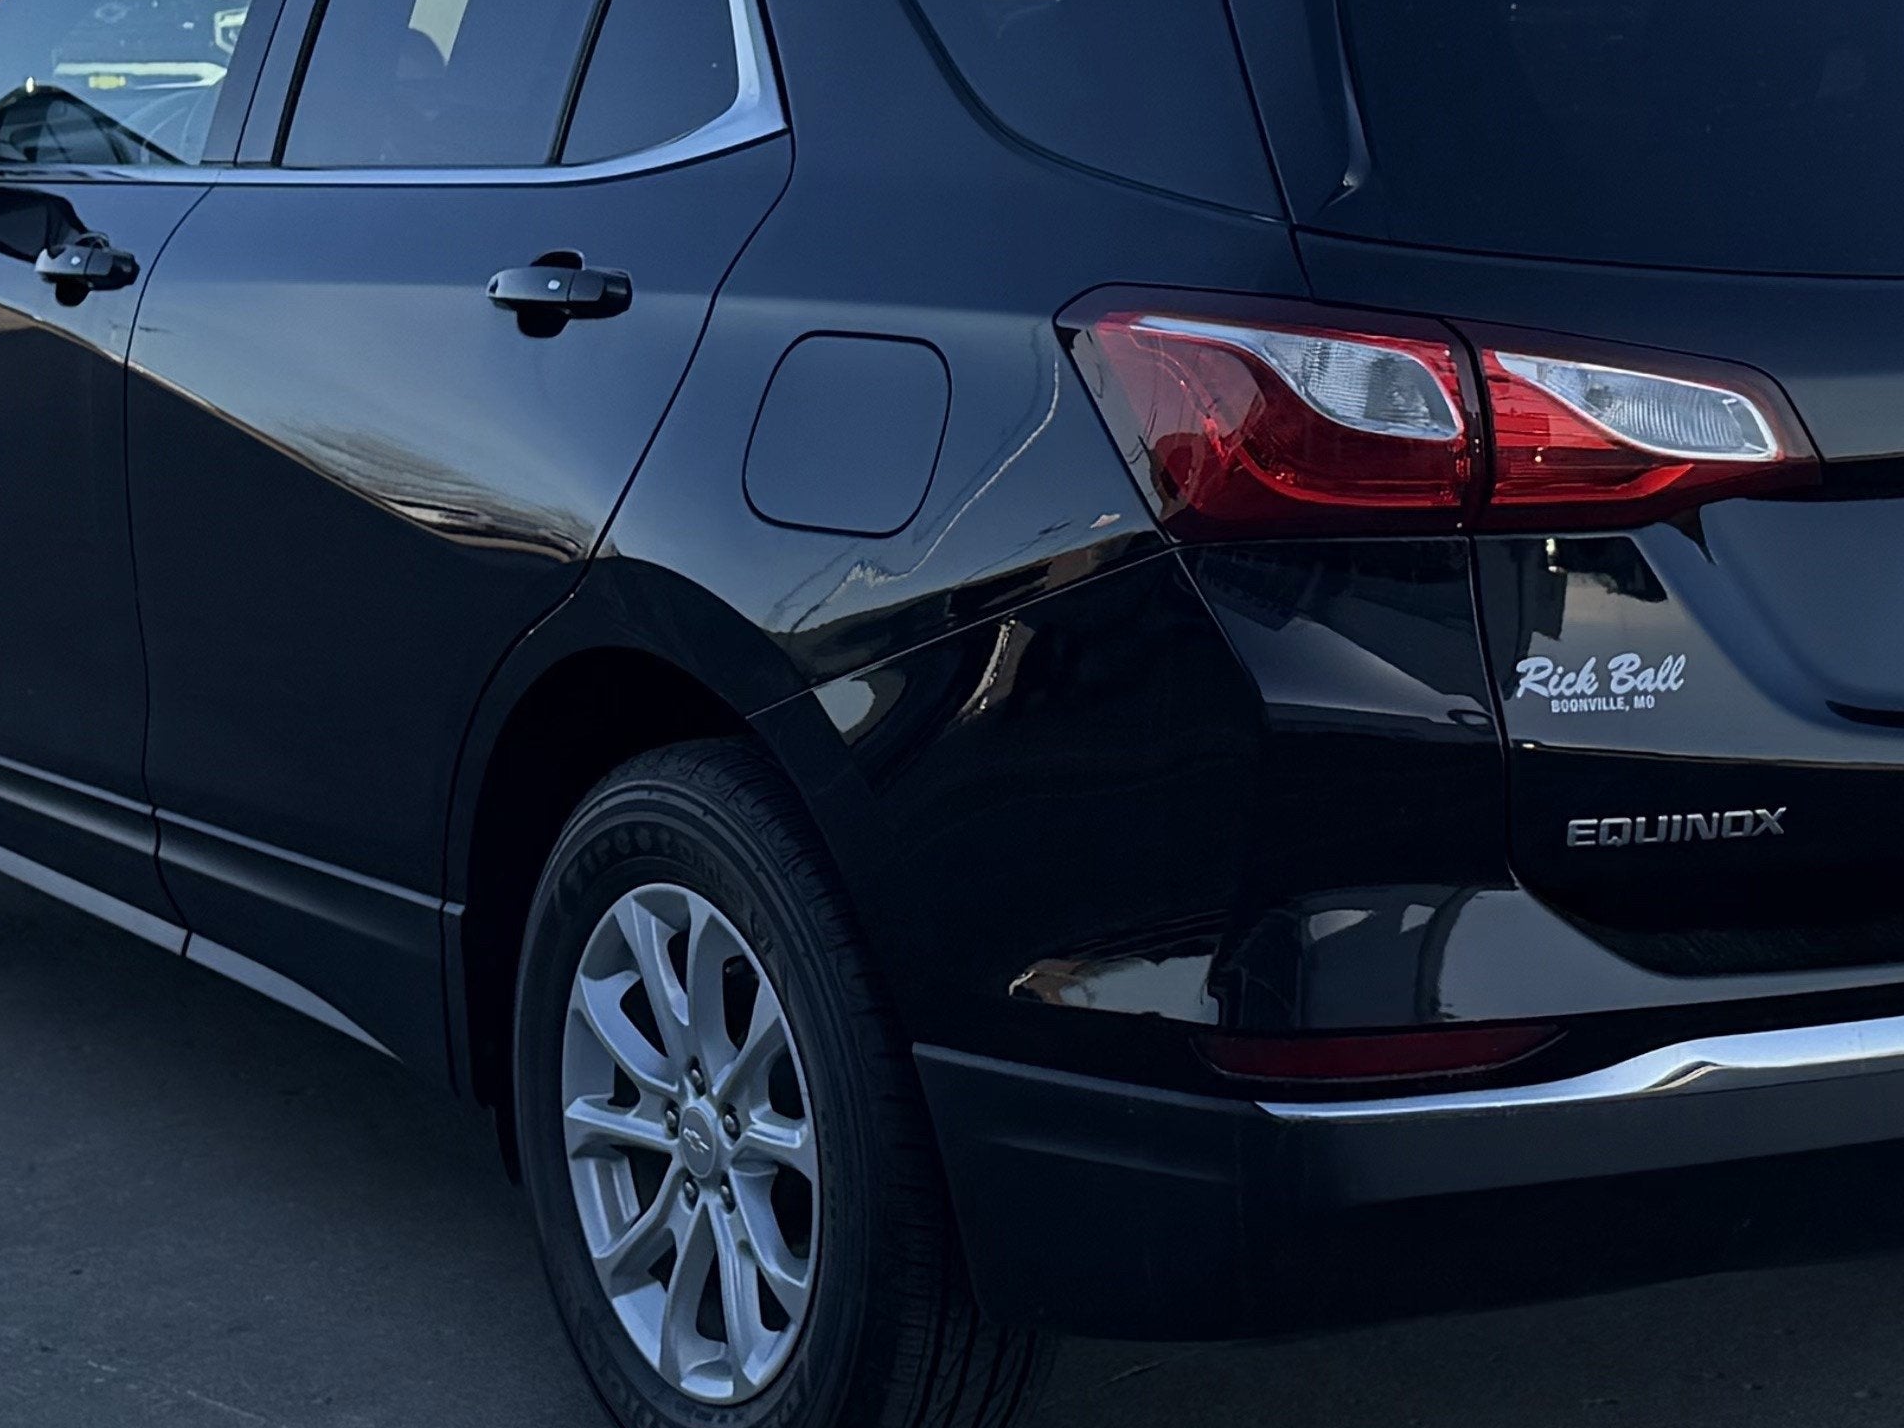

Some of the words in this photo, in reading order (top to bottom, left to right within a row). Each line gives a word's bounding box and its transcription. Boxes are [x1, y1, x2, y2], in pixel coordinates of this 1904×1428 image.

[1516, 655, 1599, 699] Rick
[1607, 652, 1687, 695] Ball
[1550, 696, 1630, 714] BOONVILLE,
[1634, 694, 1656, 710] MO
[1567, 807, 1788, 848] EQUINOX
